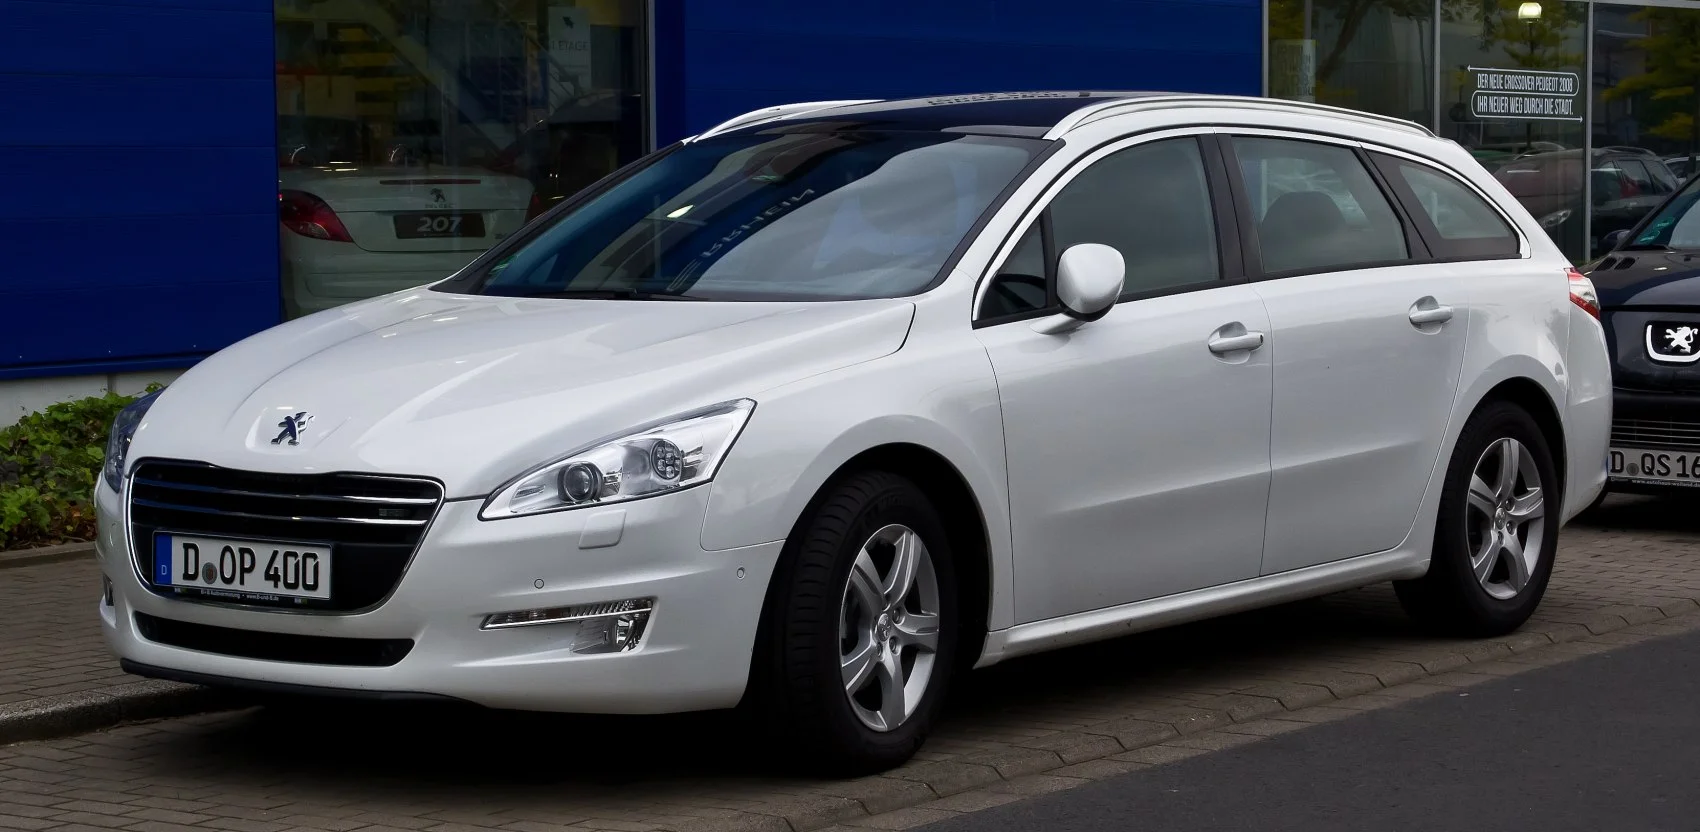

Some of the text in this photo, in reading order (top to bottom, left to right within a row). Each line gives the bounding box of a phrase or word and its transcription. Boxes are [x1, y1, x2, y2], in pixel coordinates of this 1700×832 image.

[1477, 73, 1573, 92] DER NEUE CROSSOVER PEUGEOT 2008
[1477, 95, 1574, 115] IHR NEUER WEG DURCH DIE STADT.
[416, 215, 463, 232] 207
[1610, 450, 1625, 473] D
[1641, 452, 1671, 477] QS
[161, 564, 167, 576] D
[182, 542, 319, 591] D OP 400
